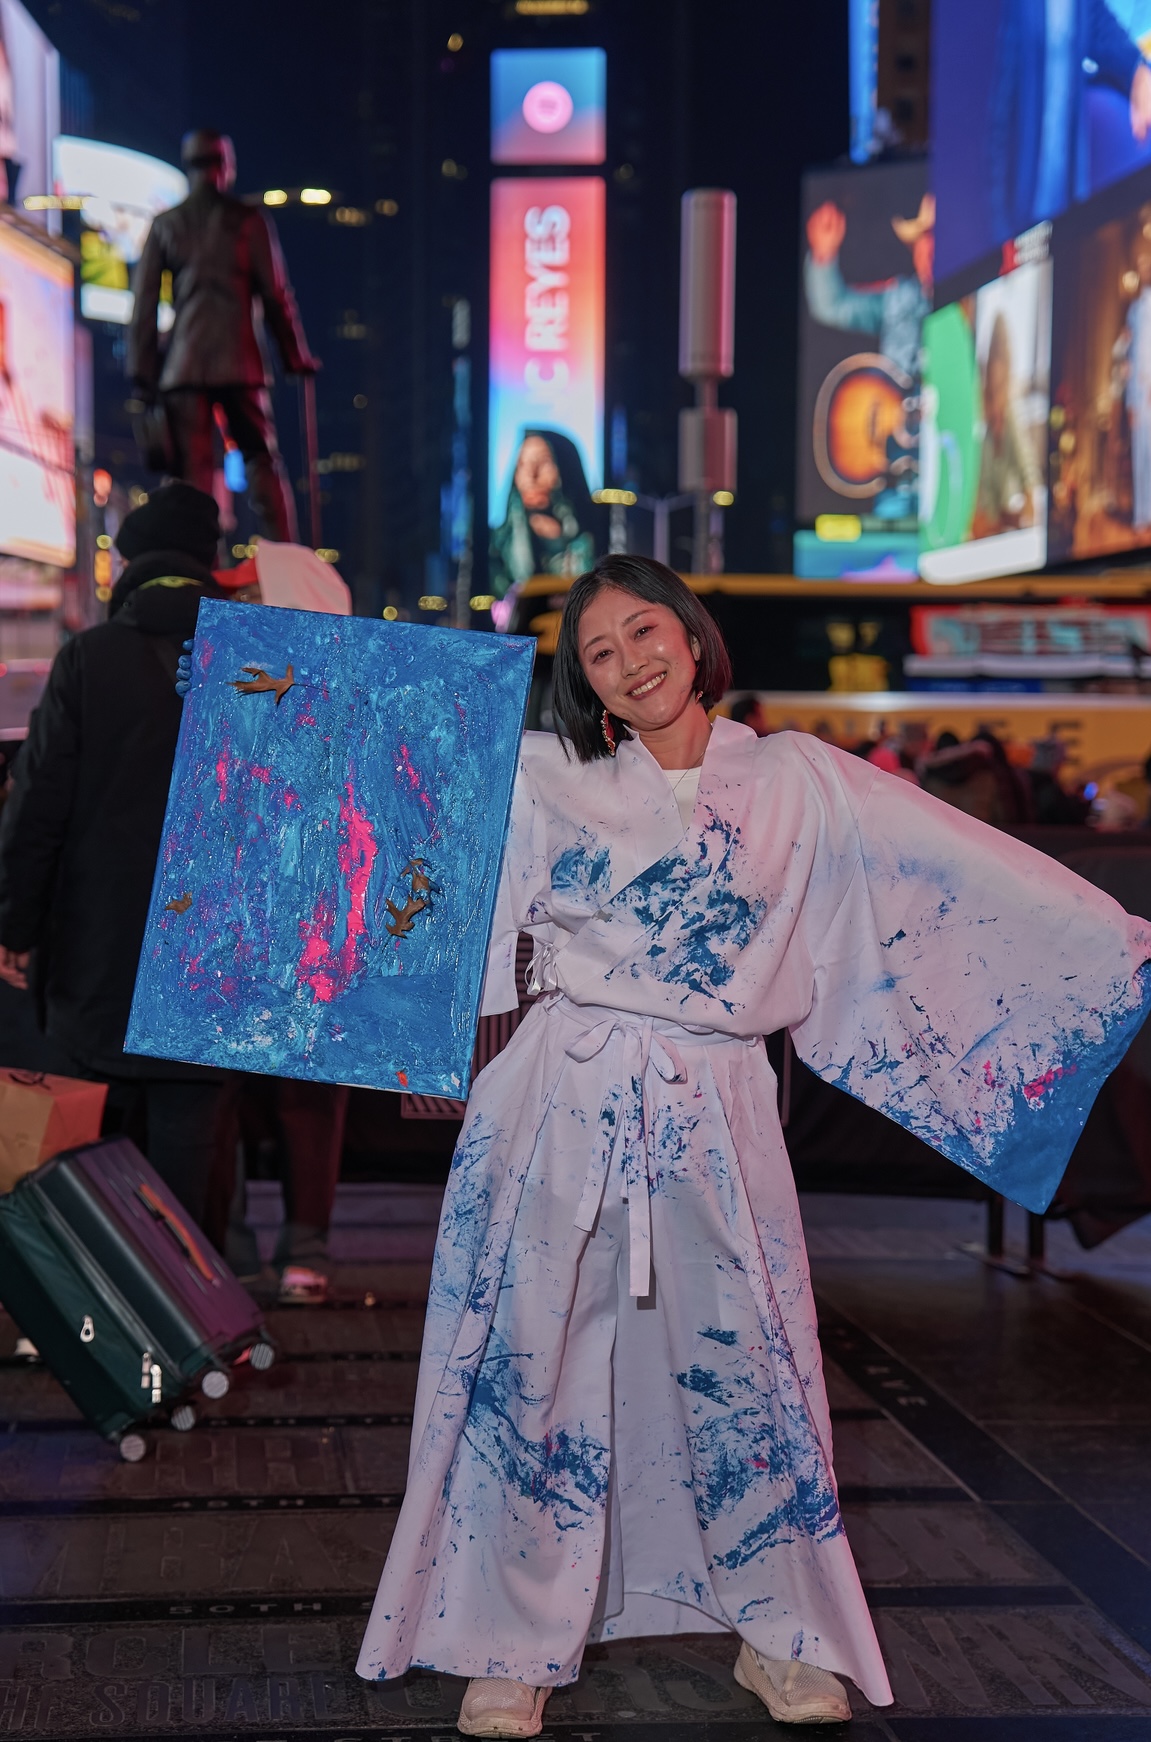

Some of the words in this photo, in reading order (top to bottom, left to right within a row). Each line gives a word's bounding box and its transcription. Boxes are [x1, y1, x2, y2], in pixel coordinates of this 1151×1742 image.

[524, 205, 571, 351] REYES
[169, 1602, 322, 1615] 50TH
[90, 1674, 345, 1727] SQUARE
